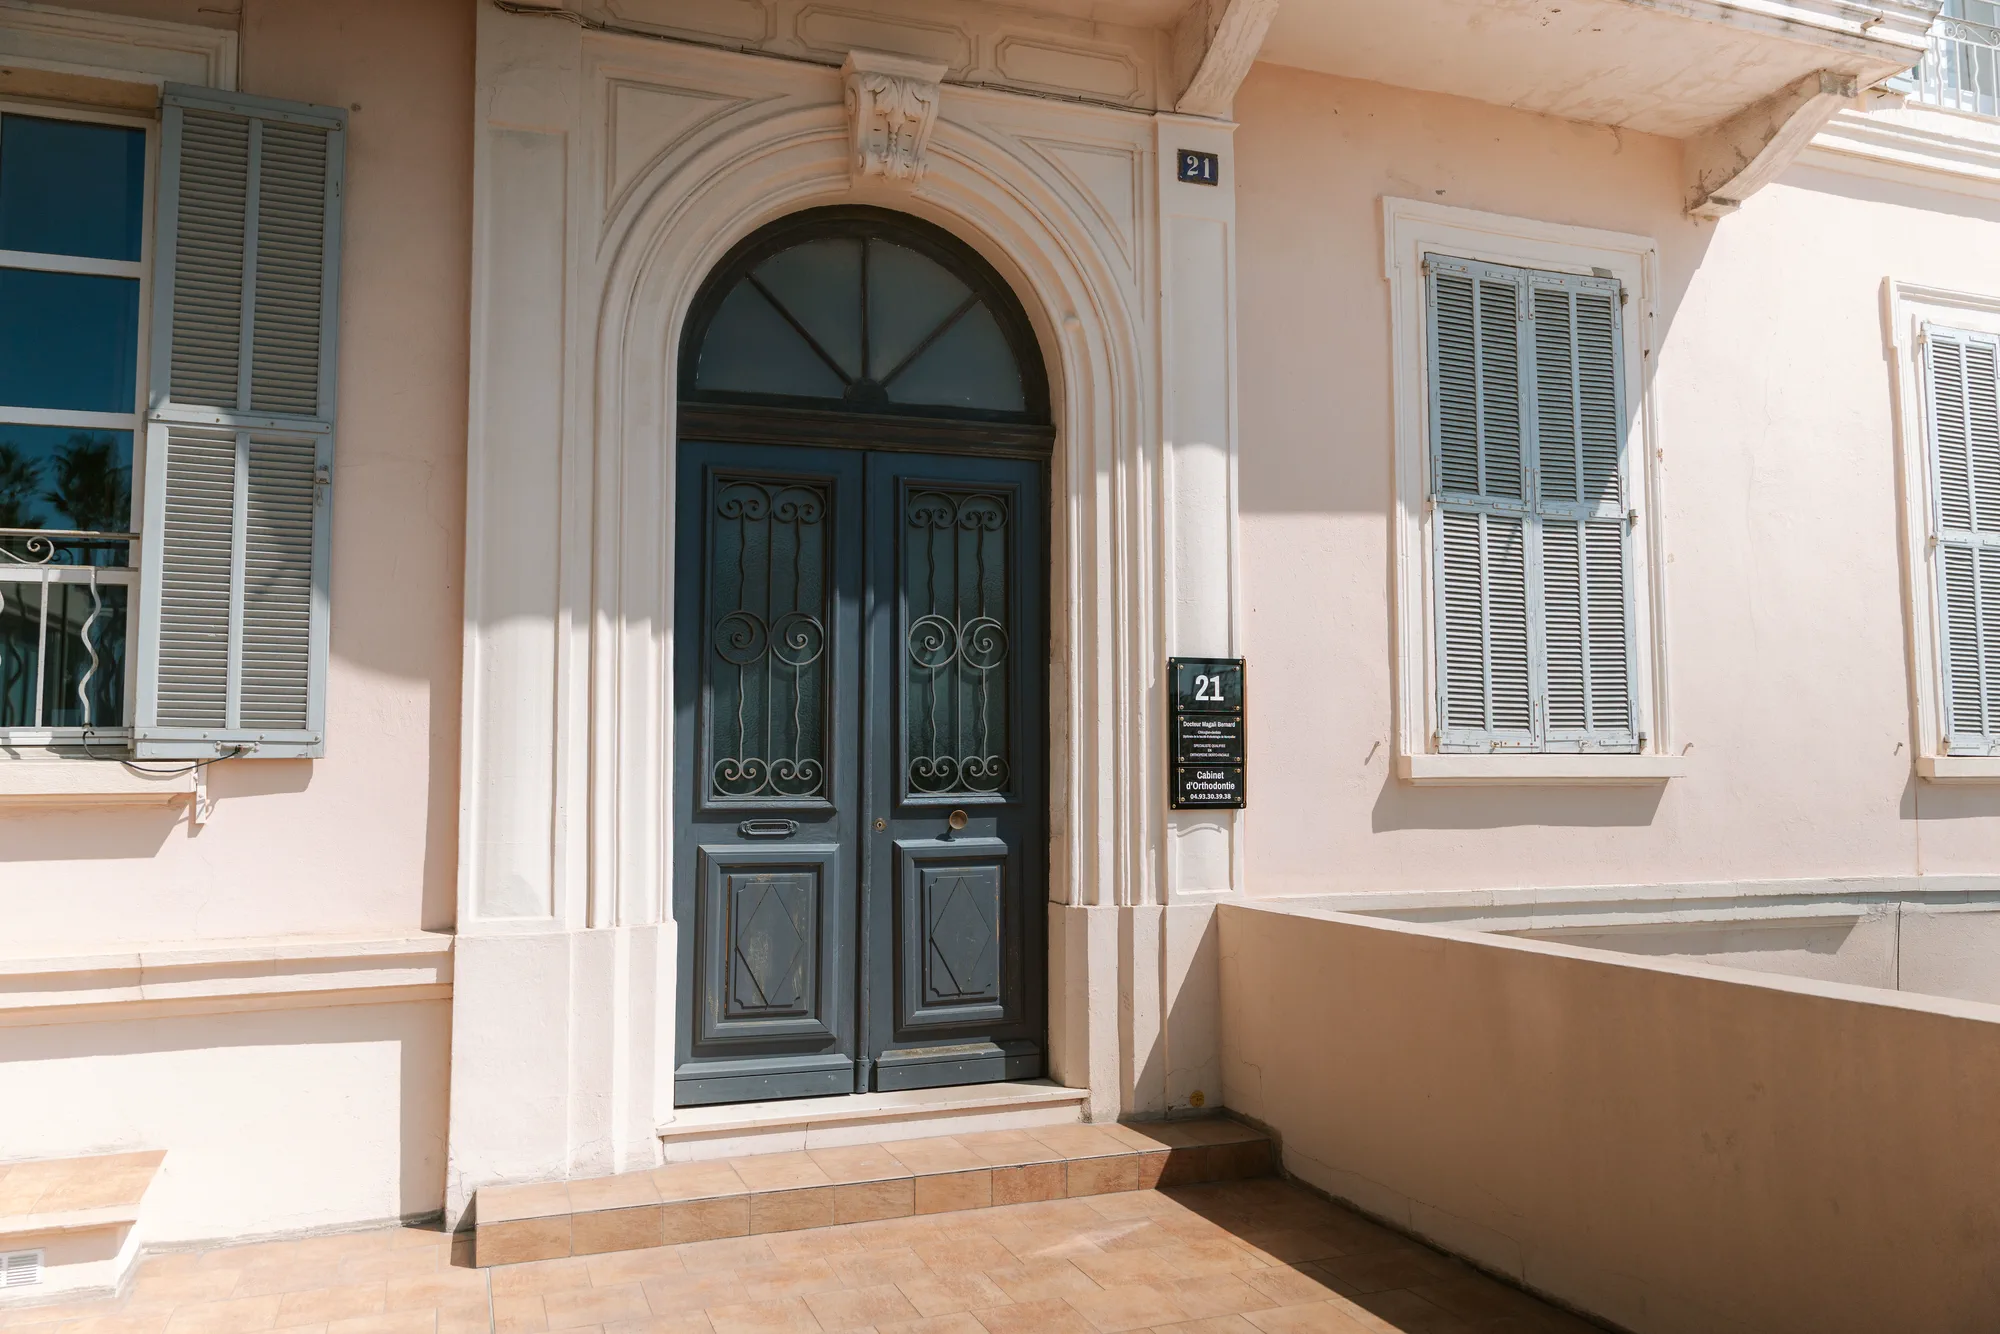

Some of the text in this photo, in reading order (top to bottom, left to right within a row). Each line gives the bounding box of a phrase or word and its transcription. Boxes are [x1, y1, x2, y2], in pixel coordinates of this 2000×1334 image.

[1186, 155, 1210, 178] 21
[1195, 674, 1225, 701] 21
[1196, 771, 1225, 779] Cabinet
[1186, 781, 1236, 790] d'Orthodontie
